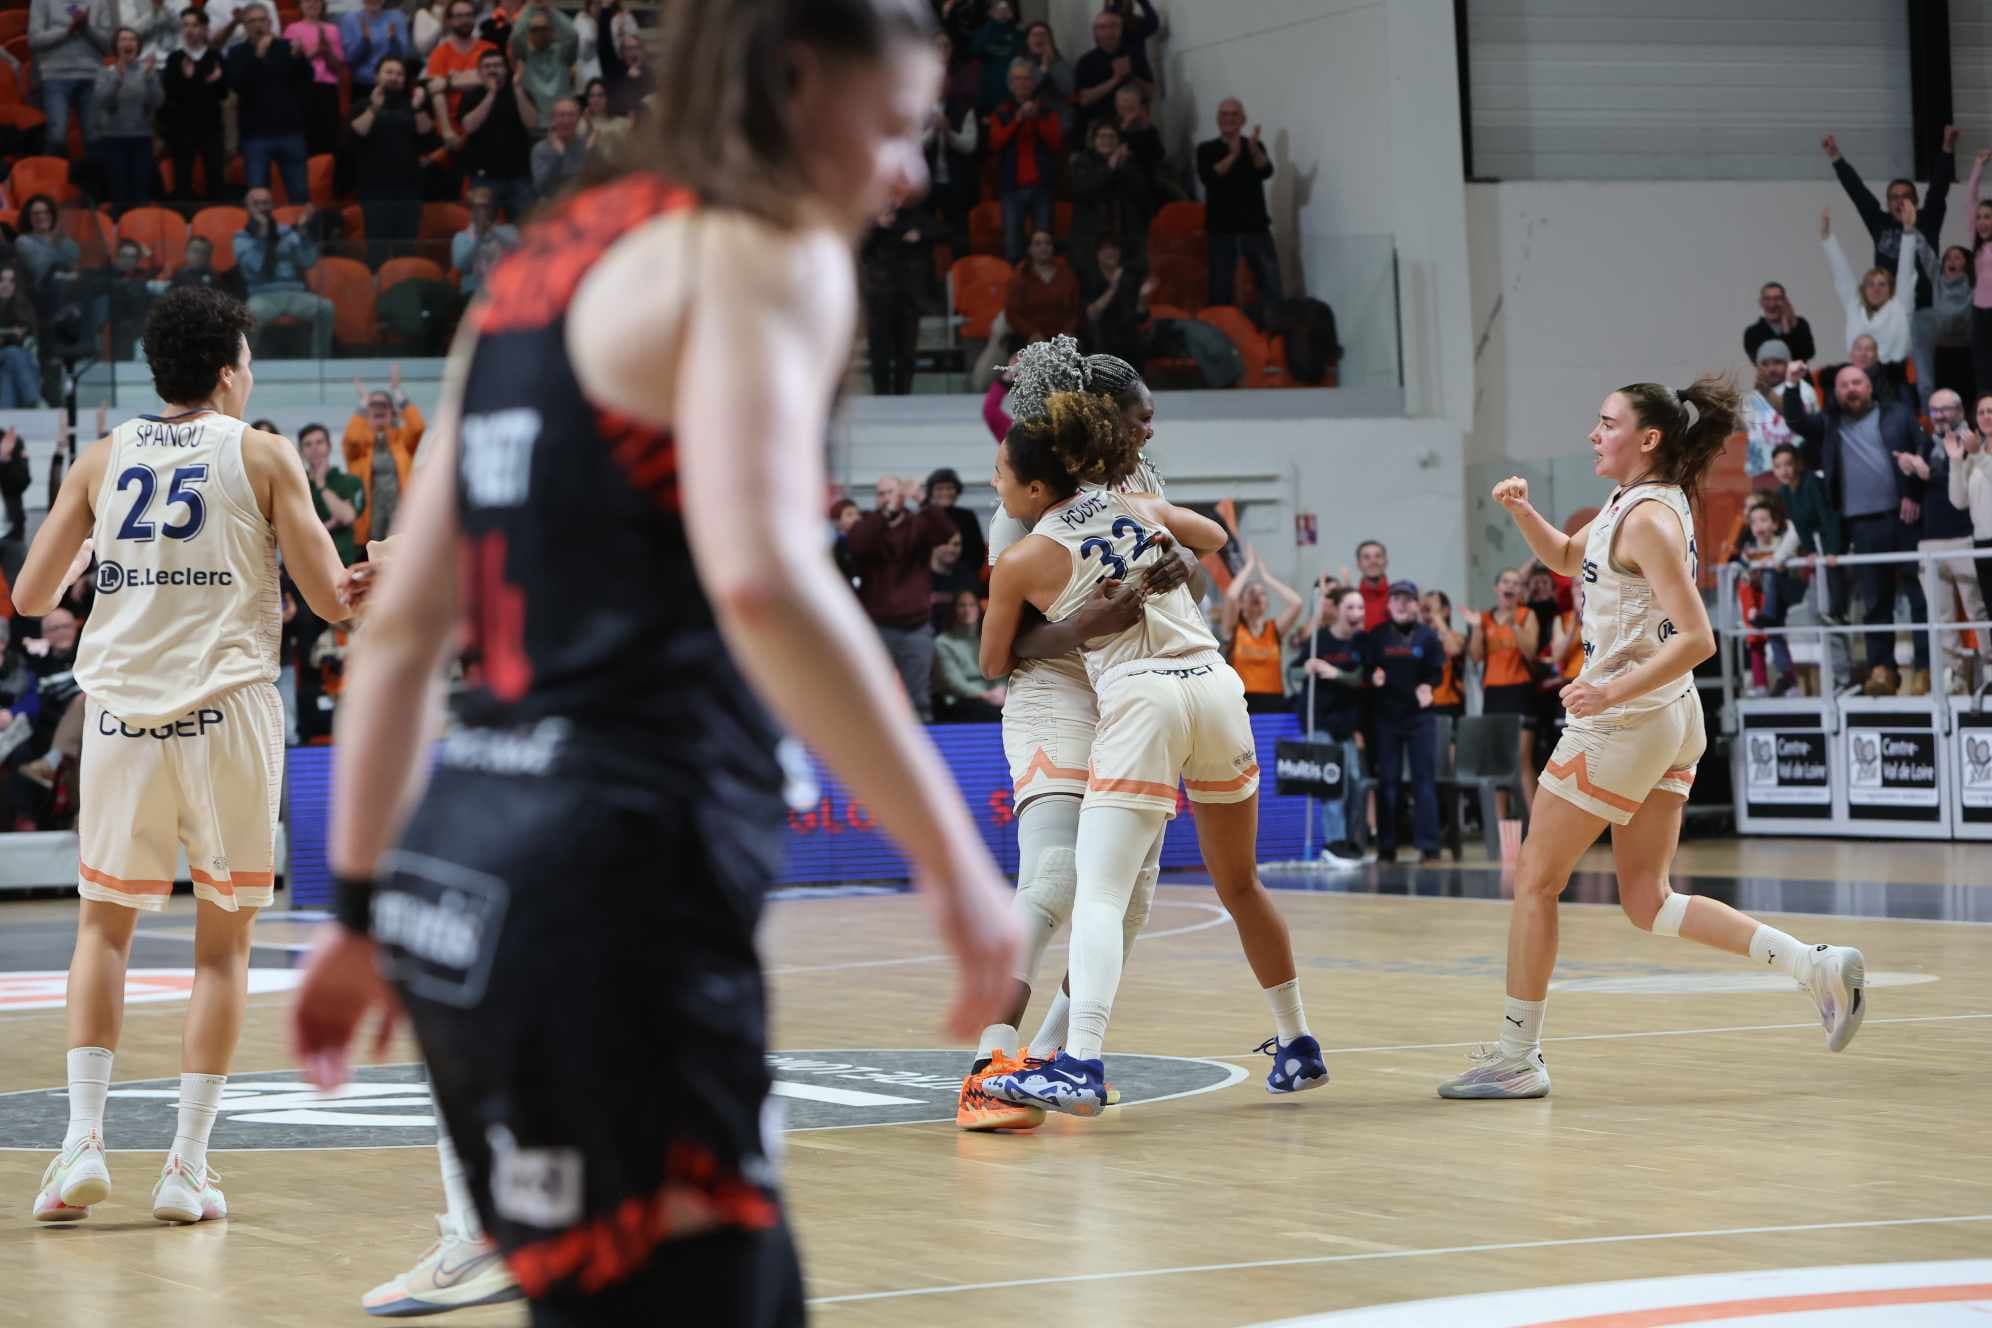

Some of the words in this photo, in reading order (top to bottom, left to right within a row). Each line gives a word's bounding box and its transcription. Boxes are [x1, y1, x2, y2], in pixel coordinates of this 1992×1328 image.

[135, 424, 205, 448] SPANOU
[116, 463, 209, 543] 25
[1080, 515, 1161, 584] 32
[127, 568, 232, 587] E.Leclerc
